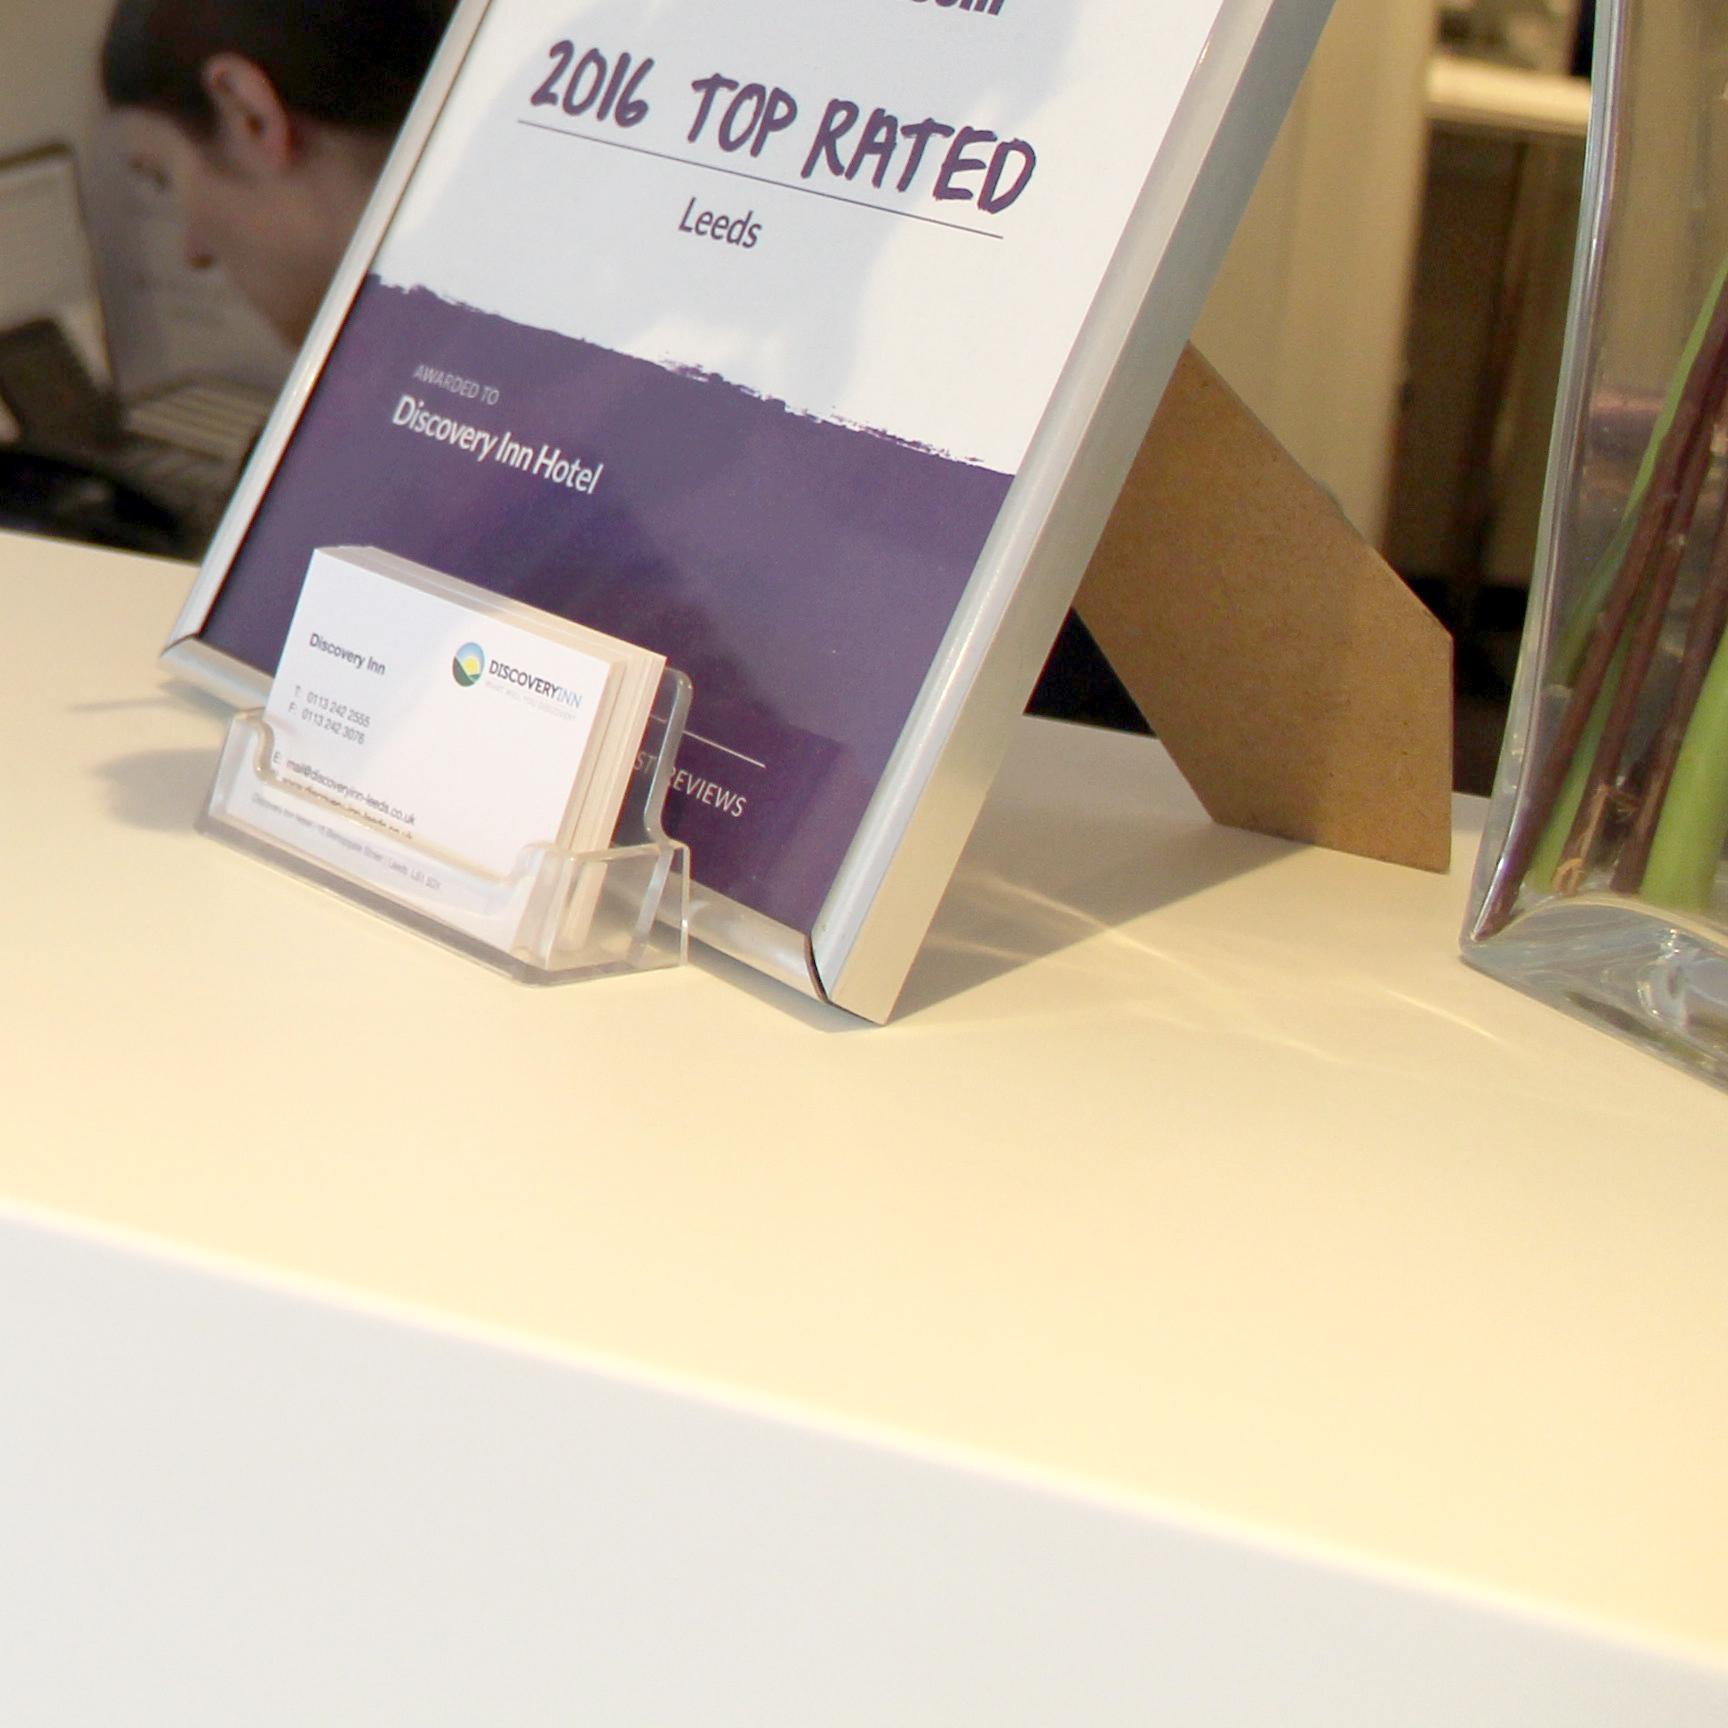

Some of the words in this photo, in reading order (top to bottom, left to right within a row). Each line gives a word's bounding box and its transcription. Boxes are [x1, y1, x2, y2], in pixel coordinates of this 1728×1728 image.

[530, 39, 654, 127] 2016
[687, 73, 797, 157] TOP
[801, 99, 1036, 214] RATED
[678, 197, 762, 249] Leeds
[413, 365, 480, 399] AWARDED
[480, 386, 500, 405] TO
[393, 394, 498, 462] Discovery
[495, 431, 533, 470] Inn
[532, 445, 604, 494] Hotel
[309, 632, 365, 669] Discovery
[366, 656, 386, 675] Inn
[672, 766, 747, 817] EVIEWS
